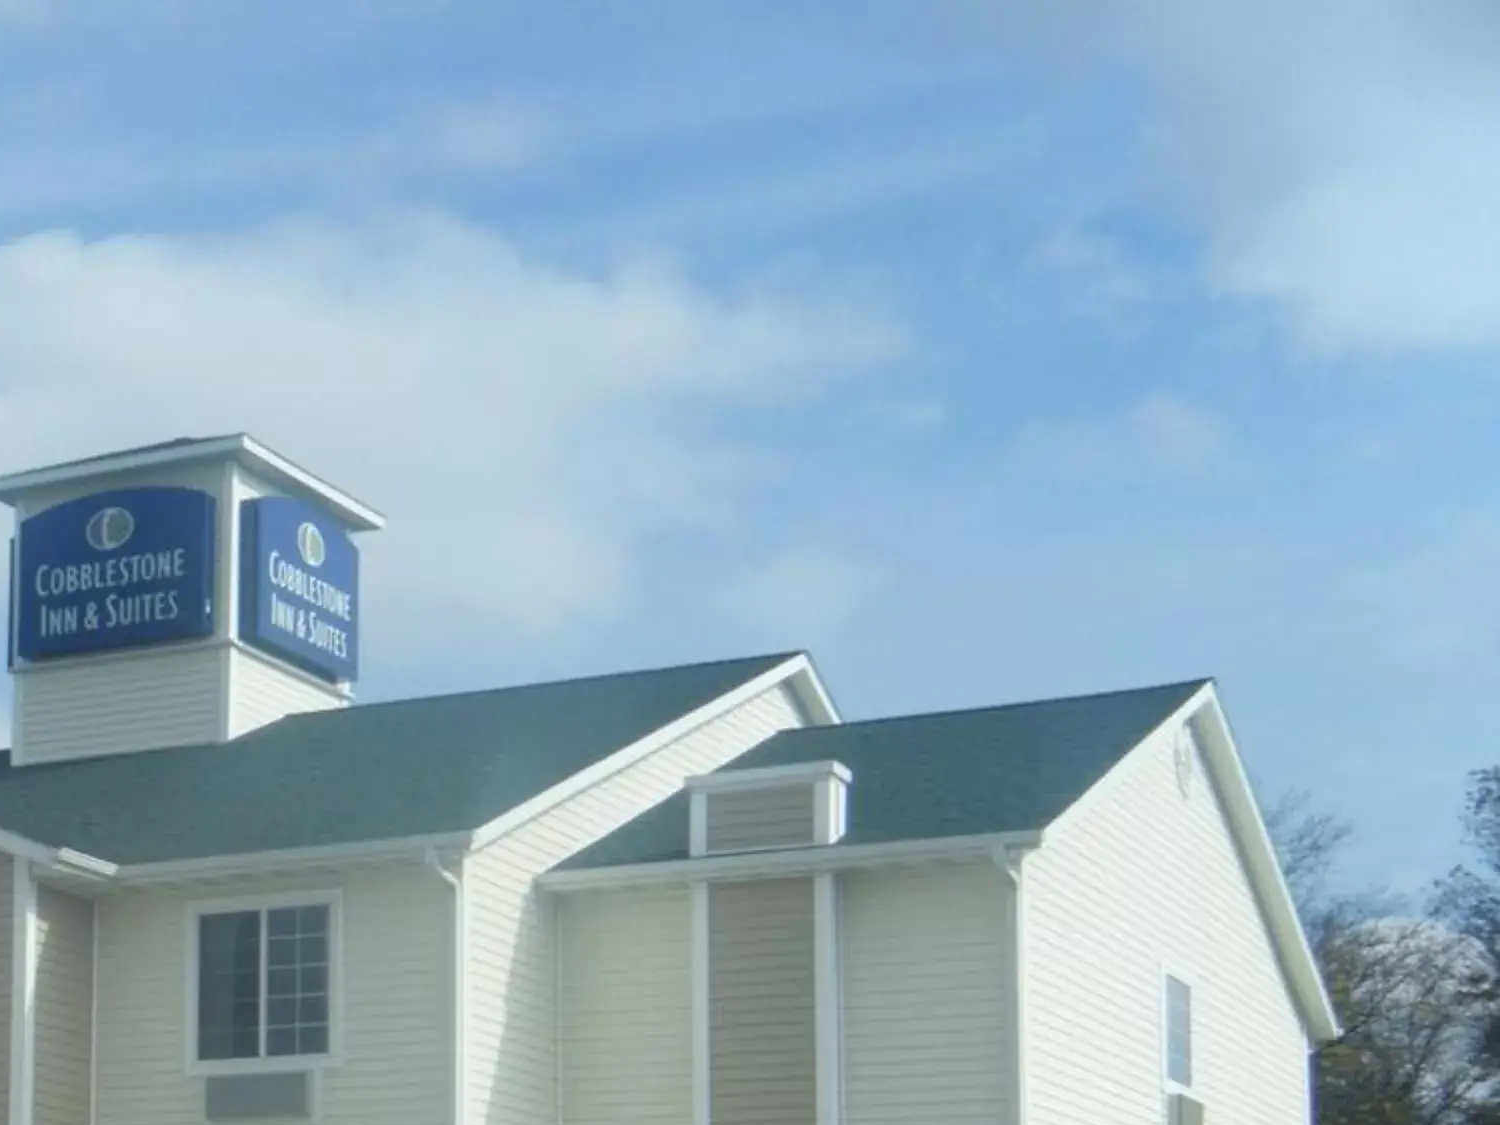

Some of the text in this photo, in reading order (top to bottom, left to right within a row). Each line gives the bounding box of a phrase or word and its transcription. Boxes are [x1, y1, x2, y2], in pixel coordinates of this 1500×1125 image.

[35, 548, 186, 597] COBBLESTONE
[269, 549, 351, 622] COBBLESTONE
[40, 591, 179, 637] INN & SUITES
[271, 593, 347, 659] INN & SUITES
